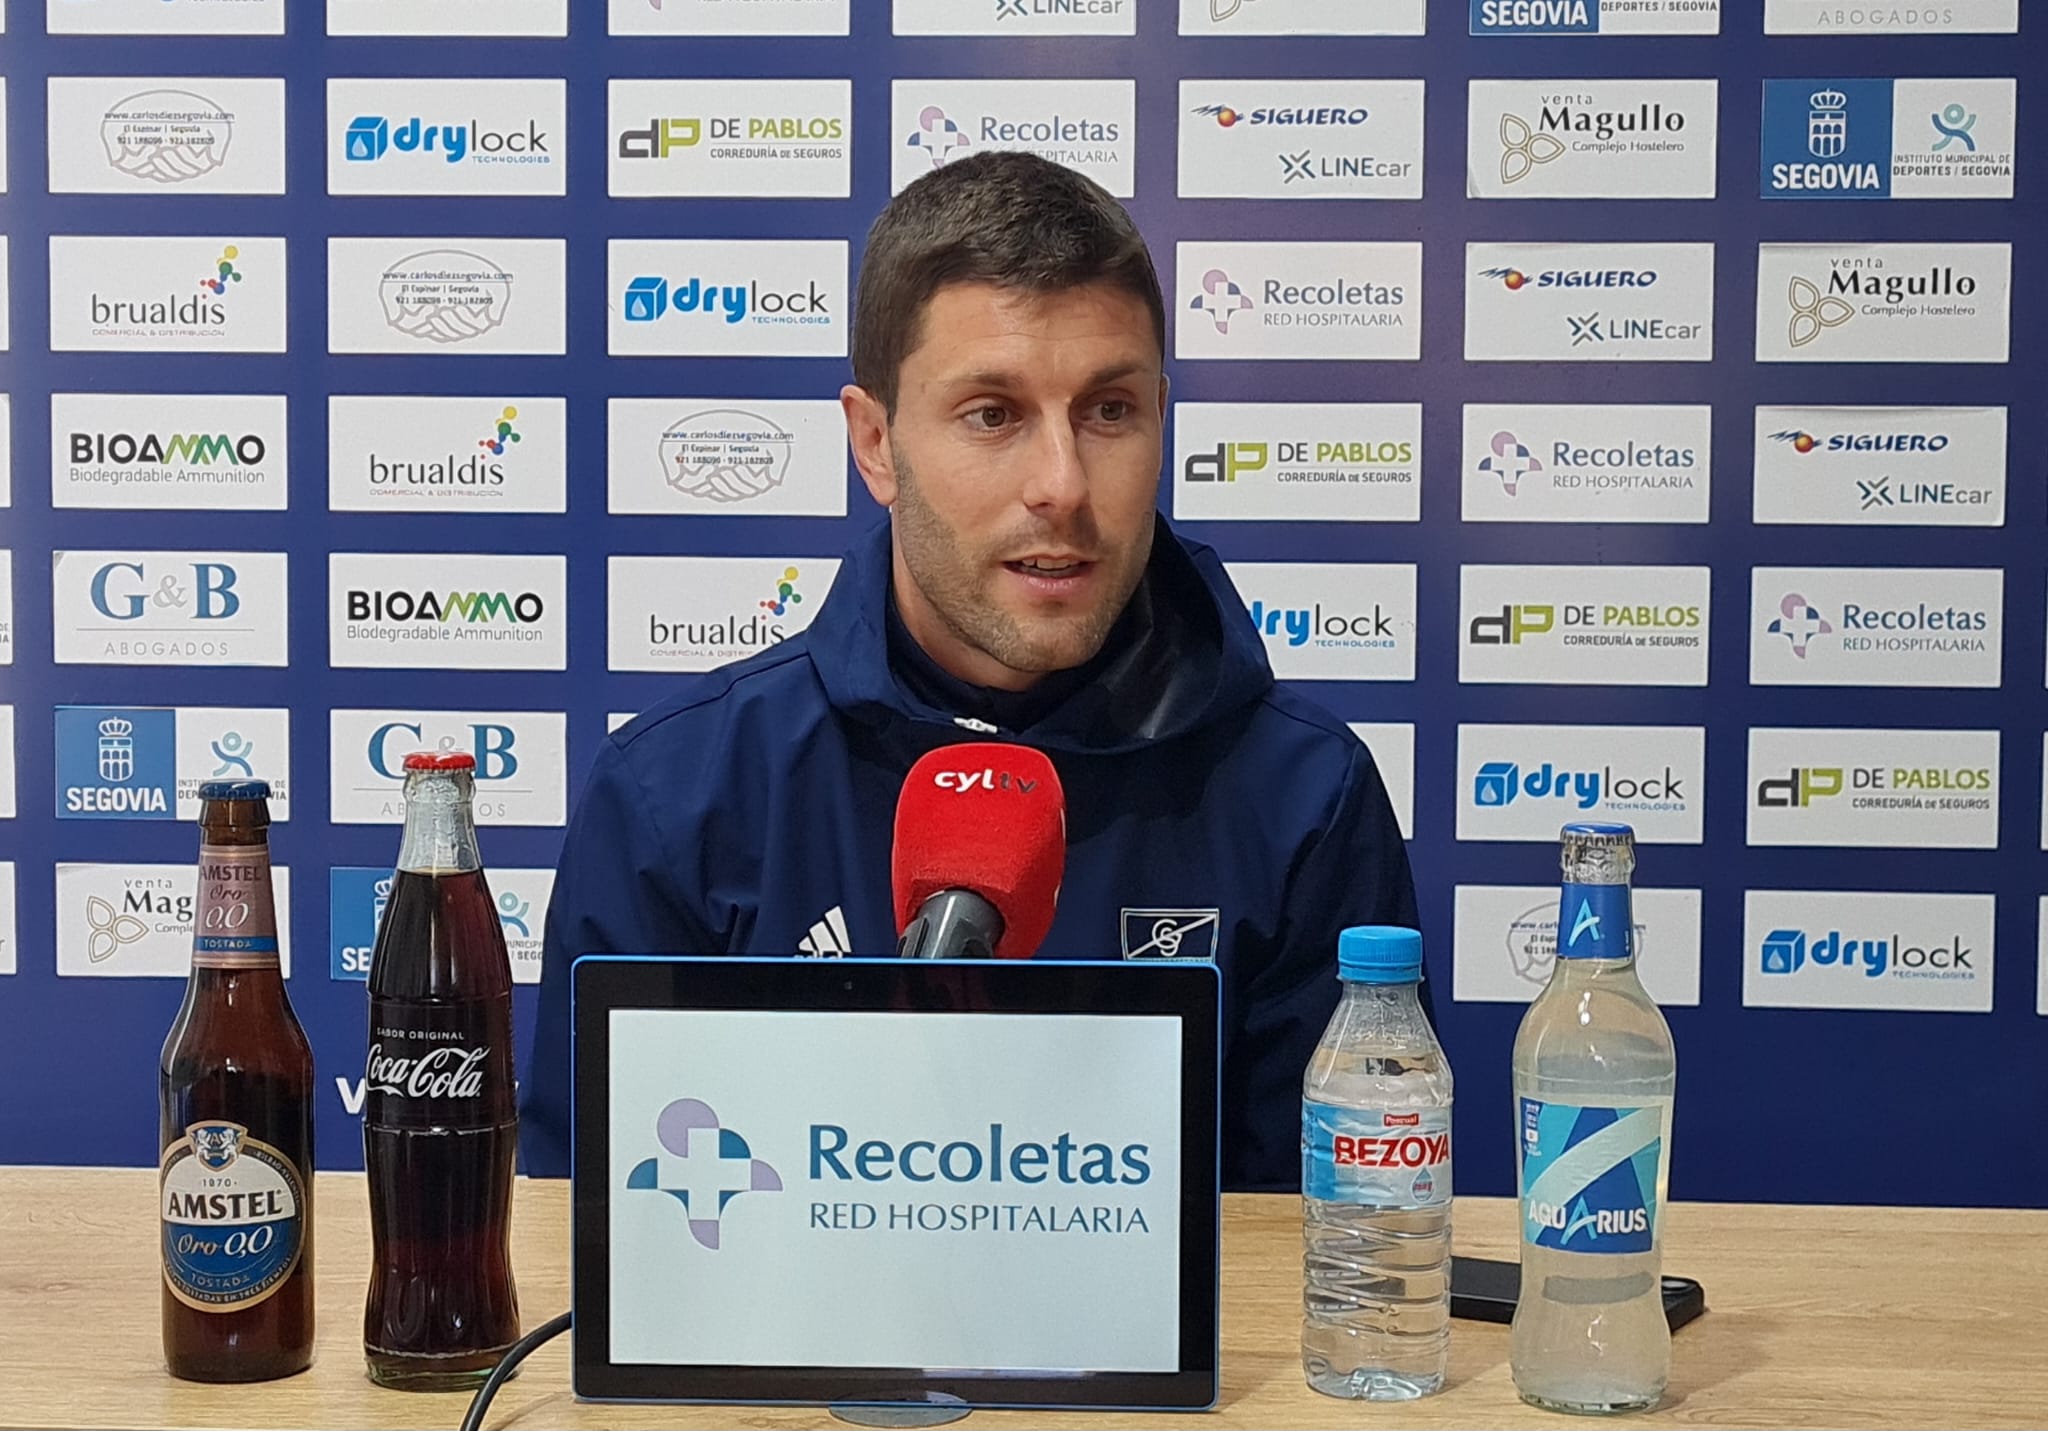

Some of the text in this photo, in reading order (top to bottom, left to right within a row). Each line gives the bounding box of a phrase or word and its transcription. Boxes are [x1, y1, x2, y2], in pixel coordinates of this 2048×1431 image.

[1033, 0, 1124, 14] LINEcar
[1480, 0, 1589, 26] SEGOVIA
[1600, 1, 1659, 12] DEPORTES
[1667, 1, 1717, 12] SEGOVIA
[1817, 8, 1954, 25] ABOGADOS
[1541, 94, 1593, 105] venta
[1249, 107, 1369, 127] SIGUERO
[1538, 104, 1686, 140] Magullo
[710, 117, 843, 140] DE PABLOS
[980, 115, 1119, 144] Recoletas
[393, 117, 550, 164] drylock
[1571, 140, 1686, 155] Complejo Hostelero
[710, 145, 779, 160] CORREDURÍA
[793, 148, 843, 160] SEGUROS
[1029, 150, 1118, 163] SPITALARIA
[1894, 154, 2011, 164] INSTITUTO MUNICIPAL DE
[1320, 157, 1412, 178] LINEcar
[1771, 163, 1880, 191] SEGOVIA
[1893, 165, 1951, 176] DEPORTES
[1961, 165, 2011, 176] SEGOVIA
[1830, 257, 1884, 268] venta
[1536, 269, 1658, 288] SIGUERO
[1826, 268, 1977, 304] Magullo
[671, 278, 829, 324] drylock
[1263, 278, 1404, 306] Recoletas
[92, 293, 226, 325] brualdis
[1263, 312, 1404, 327] RED HOSPITALARIA
[1861, 303, 1977, 319] Complejo Hostelero
[1609, 319, 1702, 341] LINEcar
[68, 433, 267, 467] BIOAMMO
[1826, 432, 1949, 452] SIGUERO
[1276, 441, 1413, 465] DE PABLOS
[1552, 440, 1695, 470] Recoletas
[69, 467, 266, 486] Biodegradable Ammunition
[369, 453, 505, 486] brualdis
[1276, 468, 1347, 483] CORREDURÍA
[1361, 471, 1413, 483] SEGUROS
[1552, 474, 1694, 489] RED HOSPITALARIA
[1899, 482, 1993, 505] LINEcar
[89, 561, 241, 622] G&B
[347, 591, 545, 624] BIOAMMO
[1563, 605, 1701, 628] DE PABLOS
[1842, 603, 1988, 633] Recoletas
[346, 624, 544, 644] Biodegradable Ammunition
[650, 613, 785, 646] brualdis
[104, 641, 230, 658] ABOGADOS
[1314, 639, 1396, 648] TECHNOLOGIES
[1563, 632, 1633, 648] CORREDURÍA
[1648, 635, 1700, 649] SEGUROS
[1843, 637, 1987, 653] RED HOSPITALARIA
[1522, 763, 1685, 810] drylock
[1852, 768, 1991, 791] DE PABLOS
[66, 786, 168, 814] SEGOVIA
[381, 801, 507, 817] ABOS
[1851, 794, 1923, 810] CORREDURÍA
[1938, 797, 1991, 810] SEGUROS
[123, 878, 173, 889] venta
[200, 865, 262, 881] AMSTEL
[154, 922, 193, 936] Compl
[505, 940, 543, 950] UNICIP
[1810, 930, 1973, 979] drylock
[517, 951, 543, 961] SEGO
[376, 1027, 465, 1041] SABOR ORIGINAL
[366, 1043, 491, 1099] Coca-Cola
[808, 1122, 1152, 1187] Recoletas
[1334, 1133, 1450, 1168] BEZOYA
[167, 1189, 284, 1220] AMSTEL
[809, 1202, 1151, 1235] RED HOSPITALARIA
[1528, 1194, 1649, 1246] AQUARIUS
[178, 1233, 218, 1257] Oro
